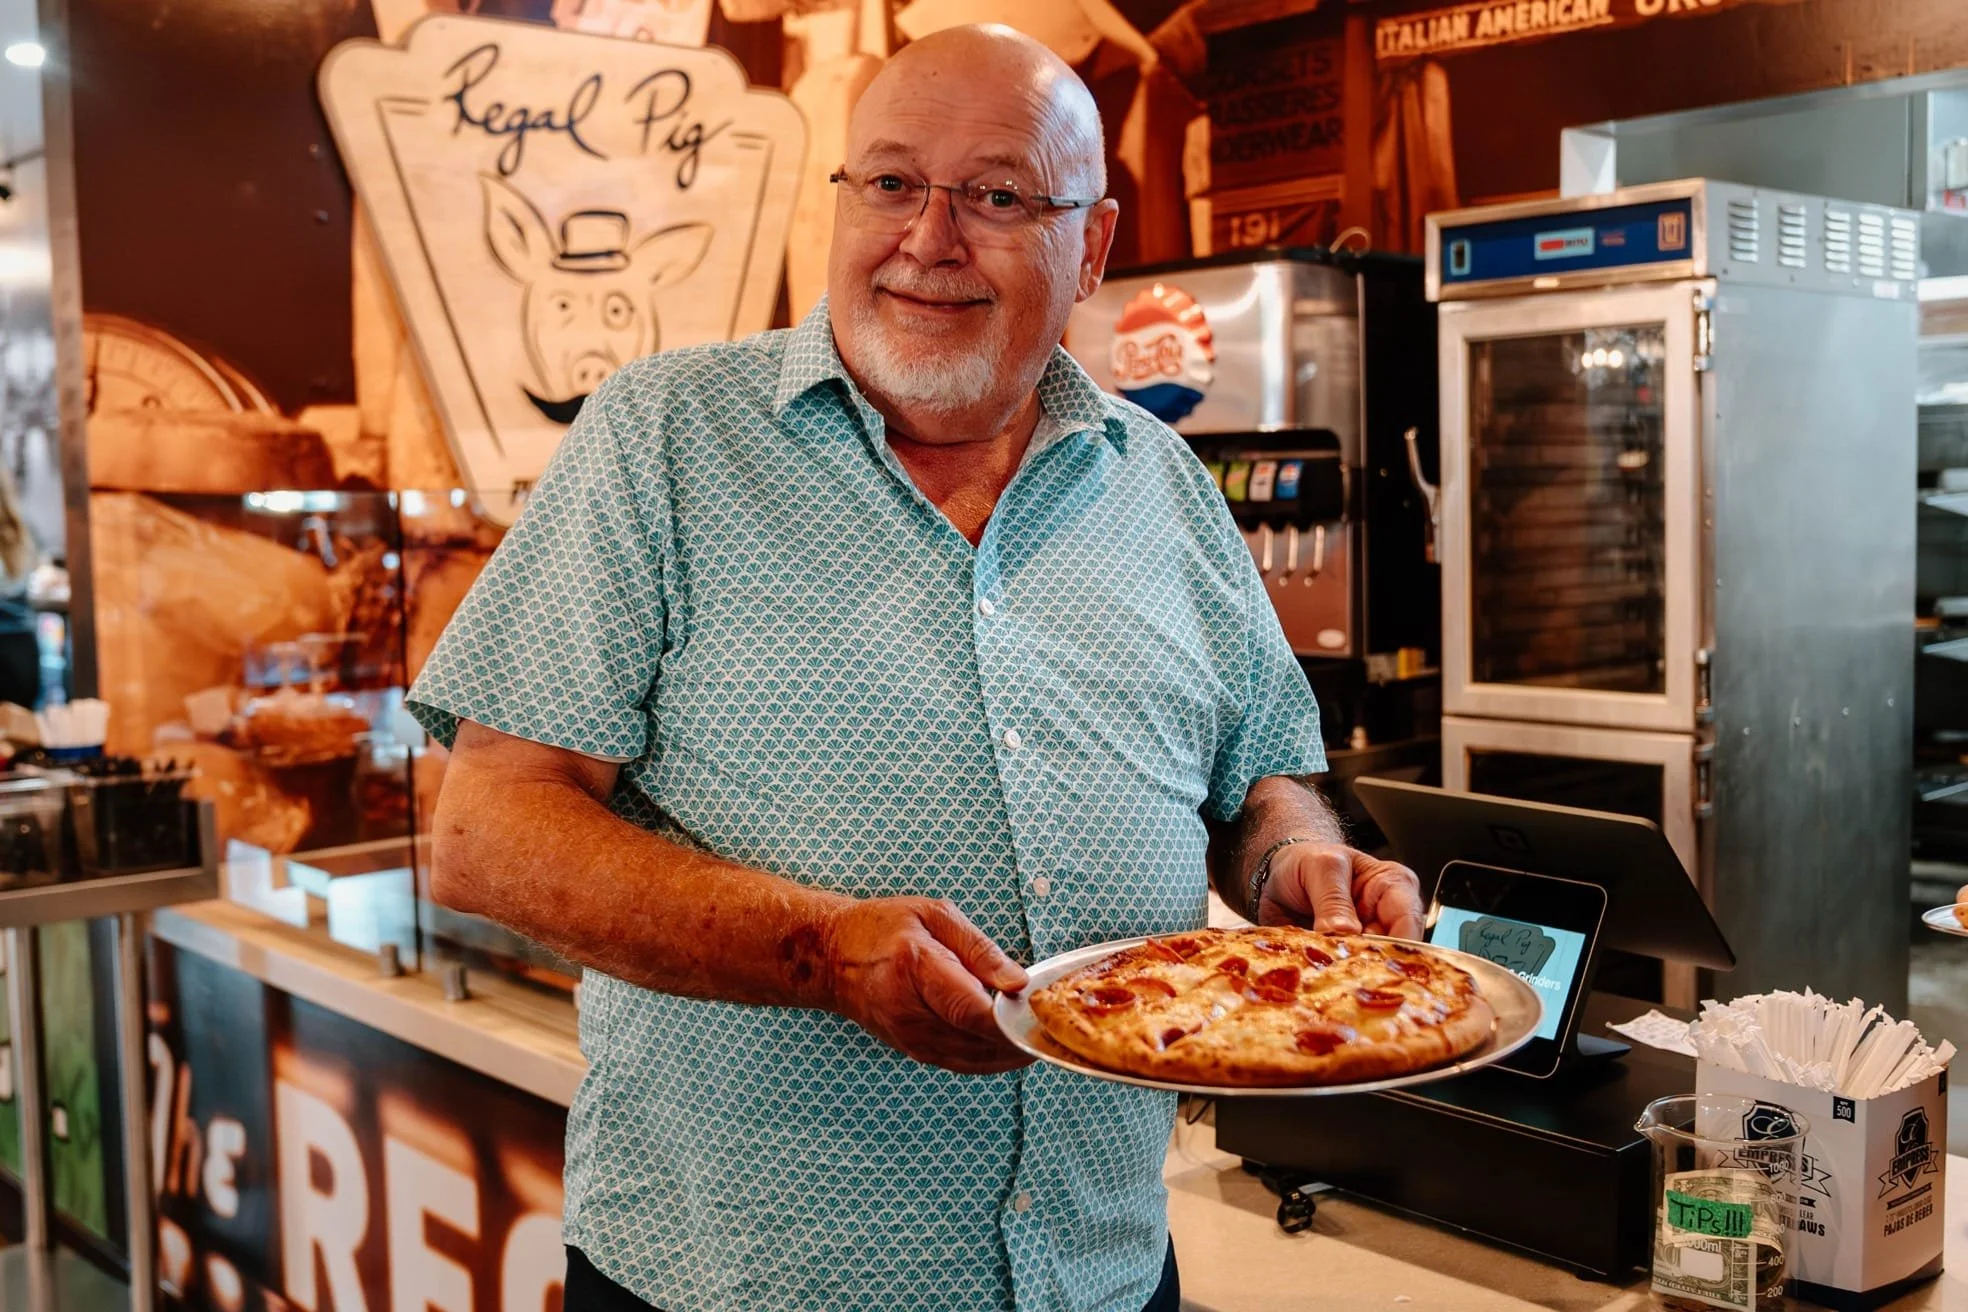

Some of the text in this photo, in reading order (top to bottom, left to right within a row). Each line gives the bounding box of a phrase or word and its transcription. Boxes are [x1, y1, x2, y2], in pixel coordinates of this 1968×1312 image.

[1375, 13, 1471, 52] ITALIAN
[1475, 0, 1610, 39] AMERICAN
[441, 42, 734, 190] Regal Pig
[1212, 117, 1345, 163] DERWEAR
[1518, 970, 1562, 991] Grinders
[1836, 1104, 1852, 1119] 500
[276, 1080, 565, 1312] RE
[1767, 1254, 1785, 1267] 400
[1767, 1285, 1784, 1299] 200
